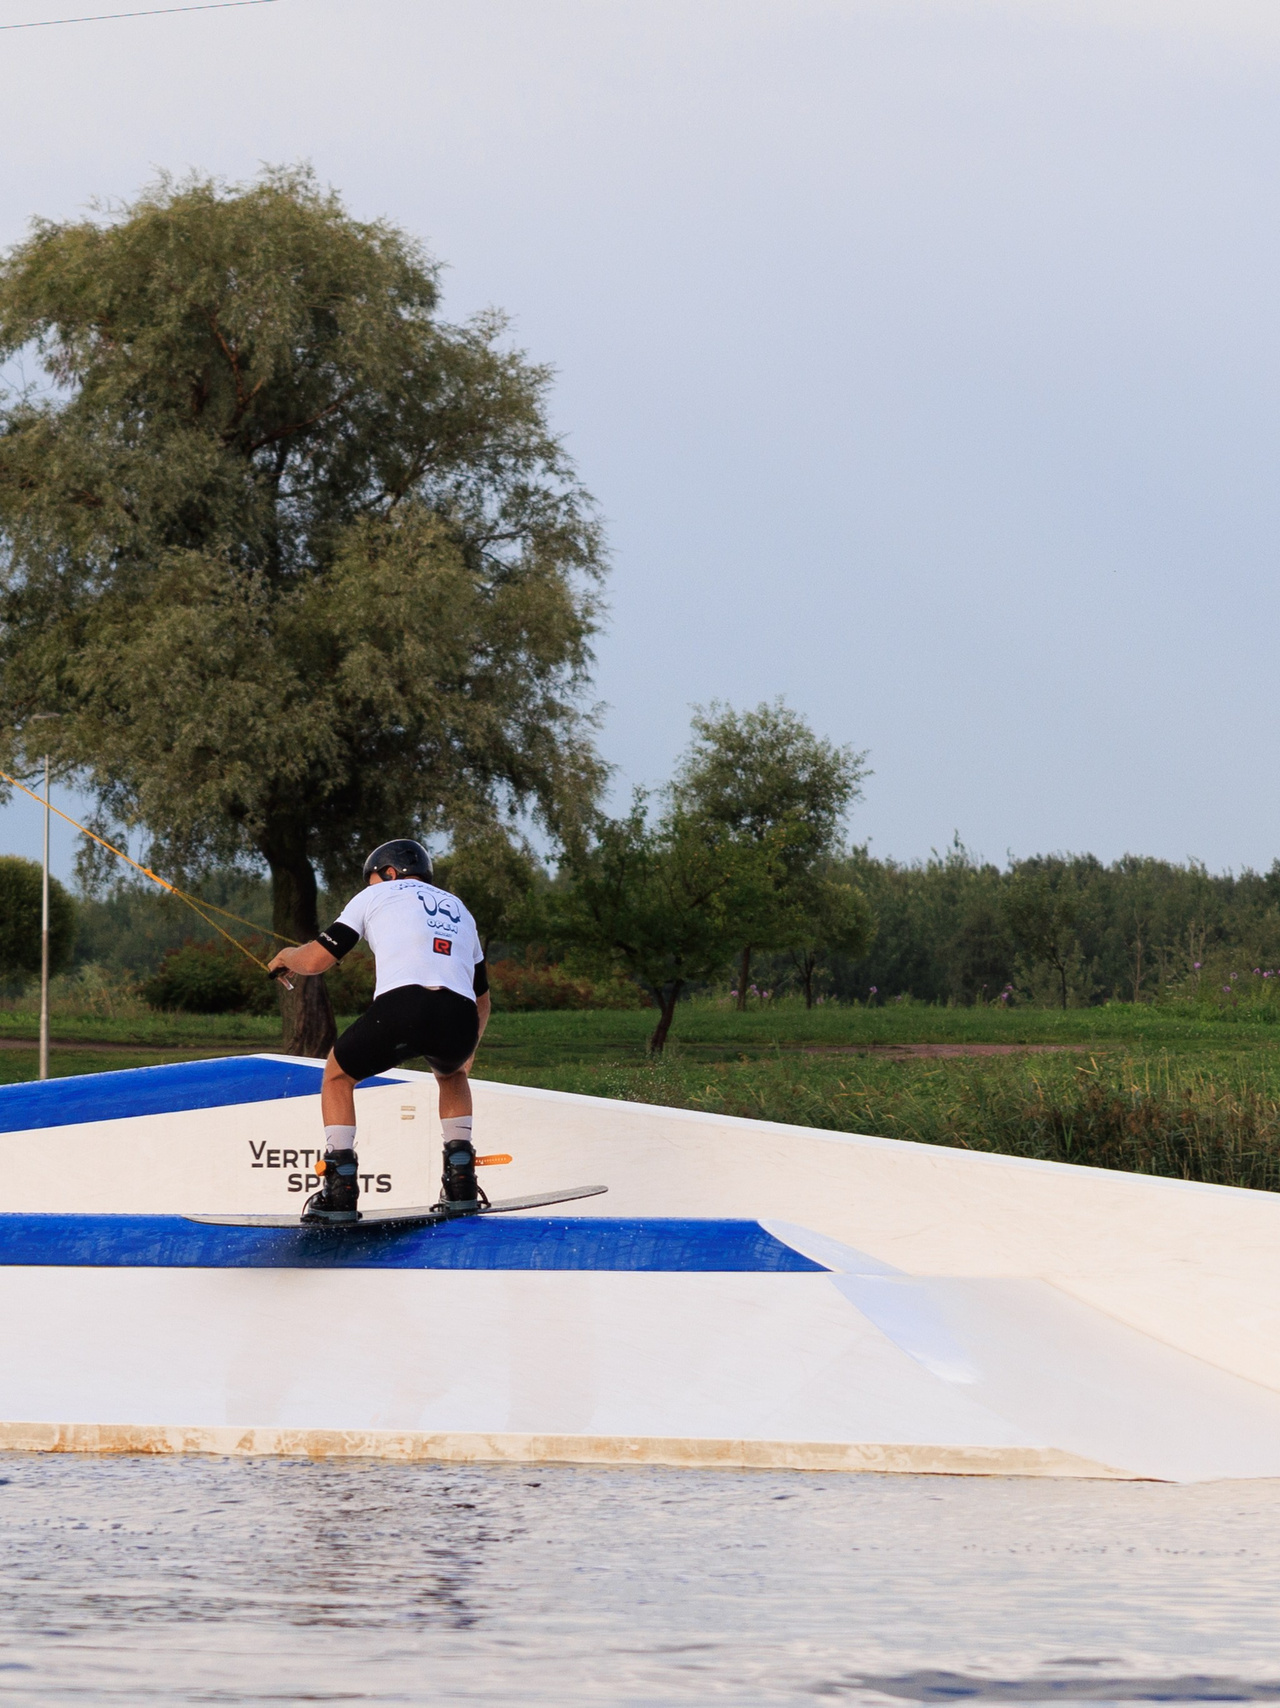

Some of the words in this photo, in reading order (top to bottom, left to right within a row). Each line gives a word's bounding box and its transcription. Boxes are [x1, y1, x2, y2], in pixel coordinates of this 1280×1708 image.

[427, 919, 459, 934] OPEN
[249, 1140, 322, 1168] VERTI
[288, 1173, 392, 1193] SPTS
